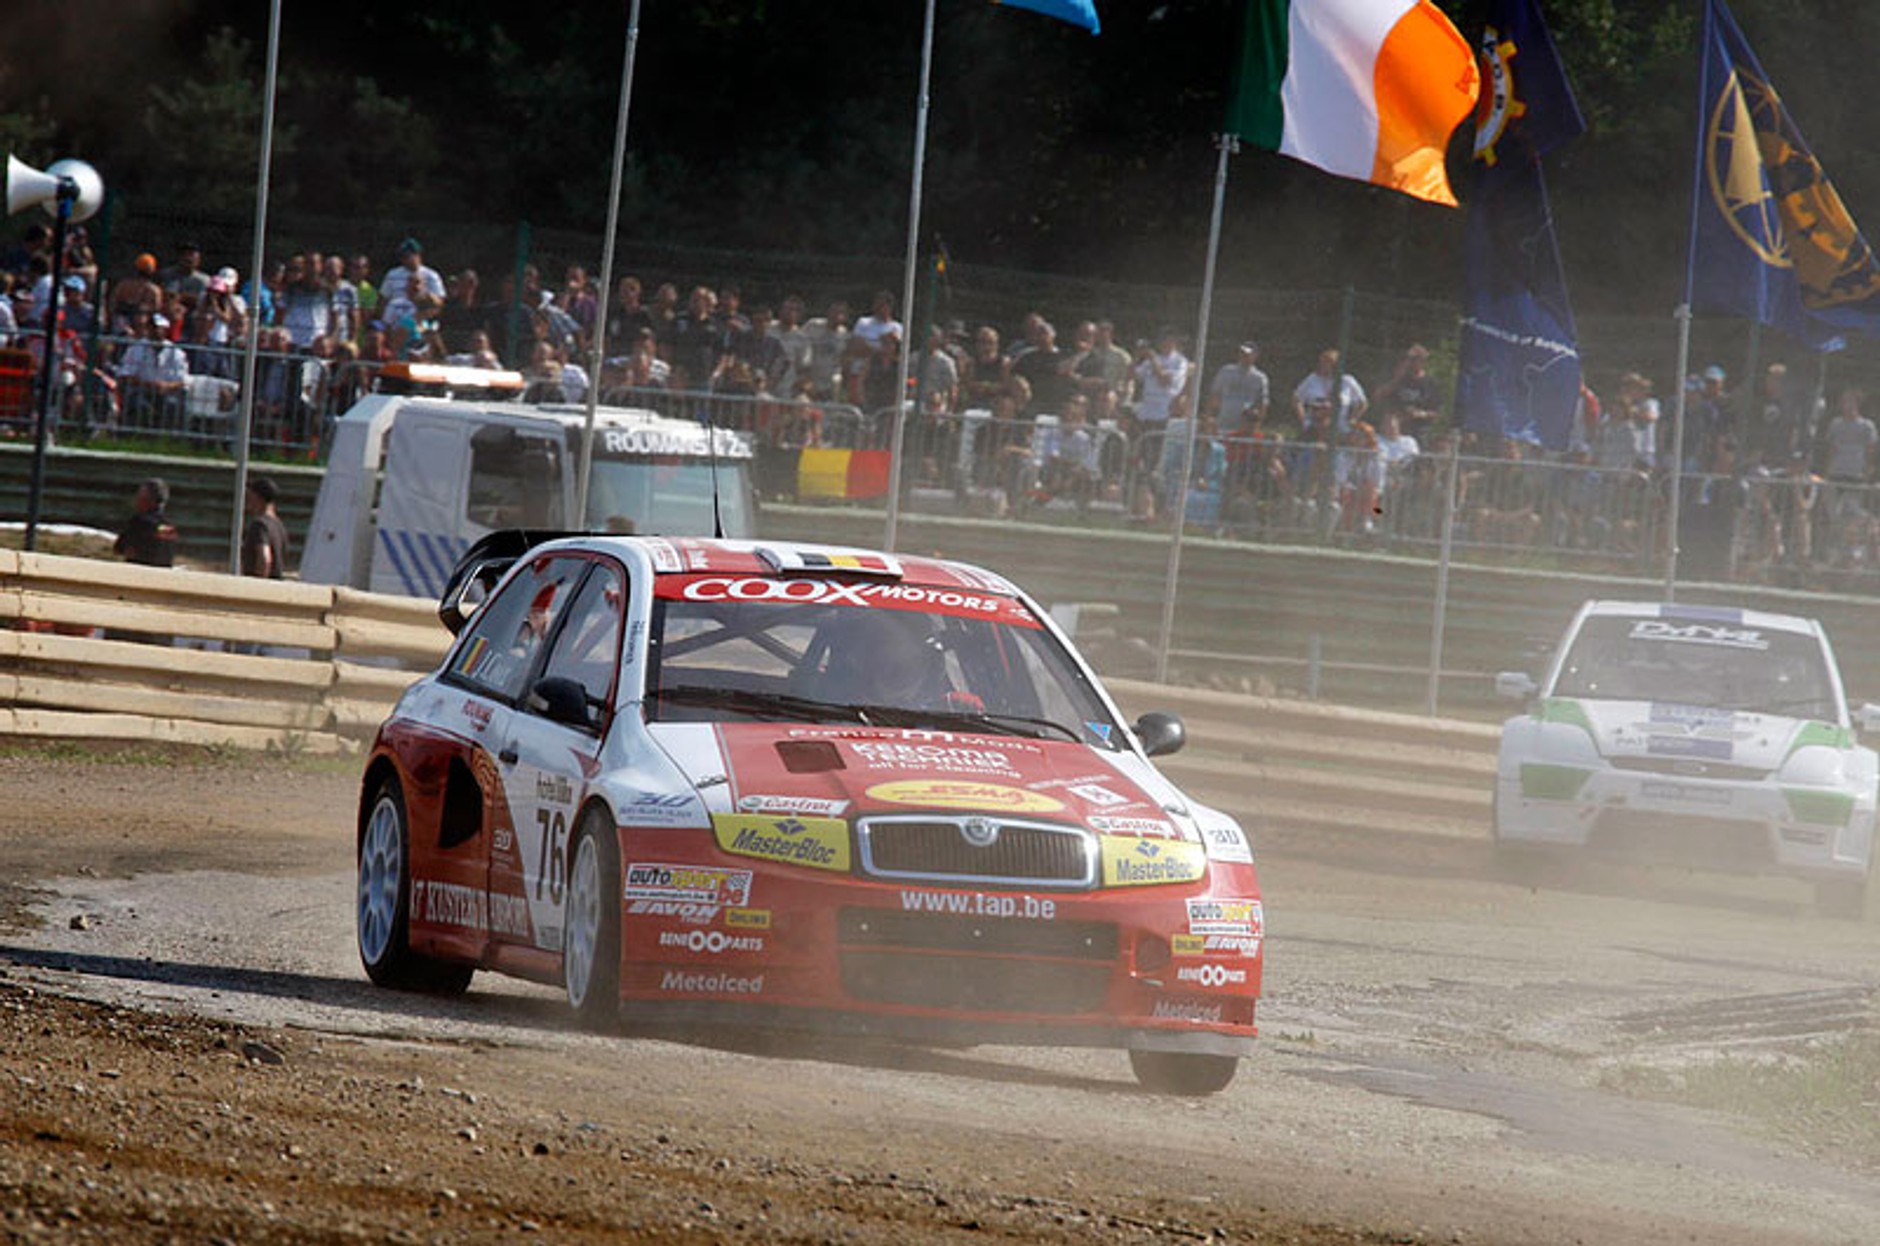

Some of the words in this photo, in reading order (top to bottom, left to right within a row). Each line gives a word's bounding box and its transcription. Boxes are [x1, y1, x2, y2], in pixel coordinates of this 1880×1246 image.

[684, 578, 869, 606] COOX
[865, 583, 999, 613] MOTORS
[536, 807, 566, 906] 76
[731, 827, 836, 864] MasterBloc
[648, 901, 721, 918] AVON
[901, 889, 1057, 920] www.tap.be
